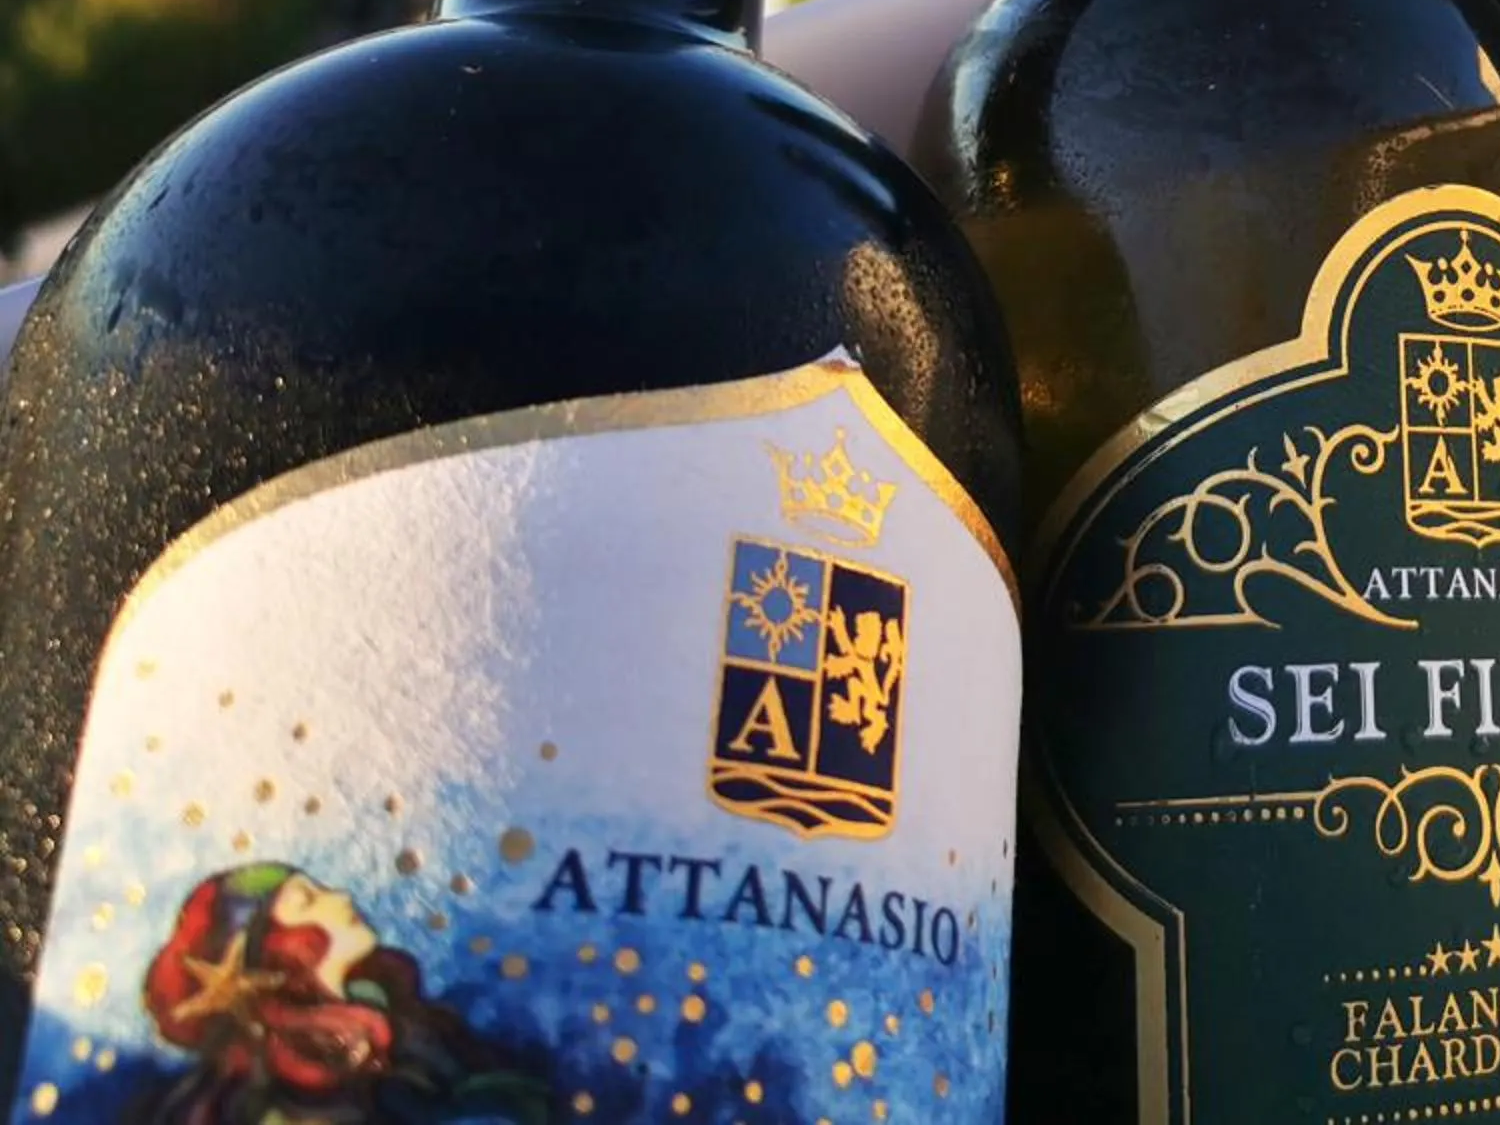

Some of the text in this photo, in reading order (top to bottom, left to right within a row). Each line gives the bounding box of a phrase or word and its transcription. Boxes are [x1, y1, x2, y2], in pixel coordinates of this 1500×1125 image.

[1417, 434, 1469, 495] A
[727, 677, 802, 762] A
[1227, 660, 1388, 747] SEI
[529, 848, 961, 968] ATTANASIO
